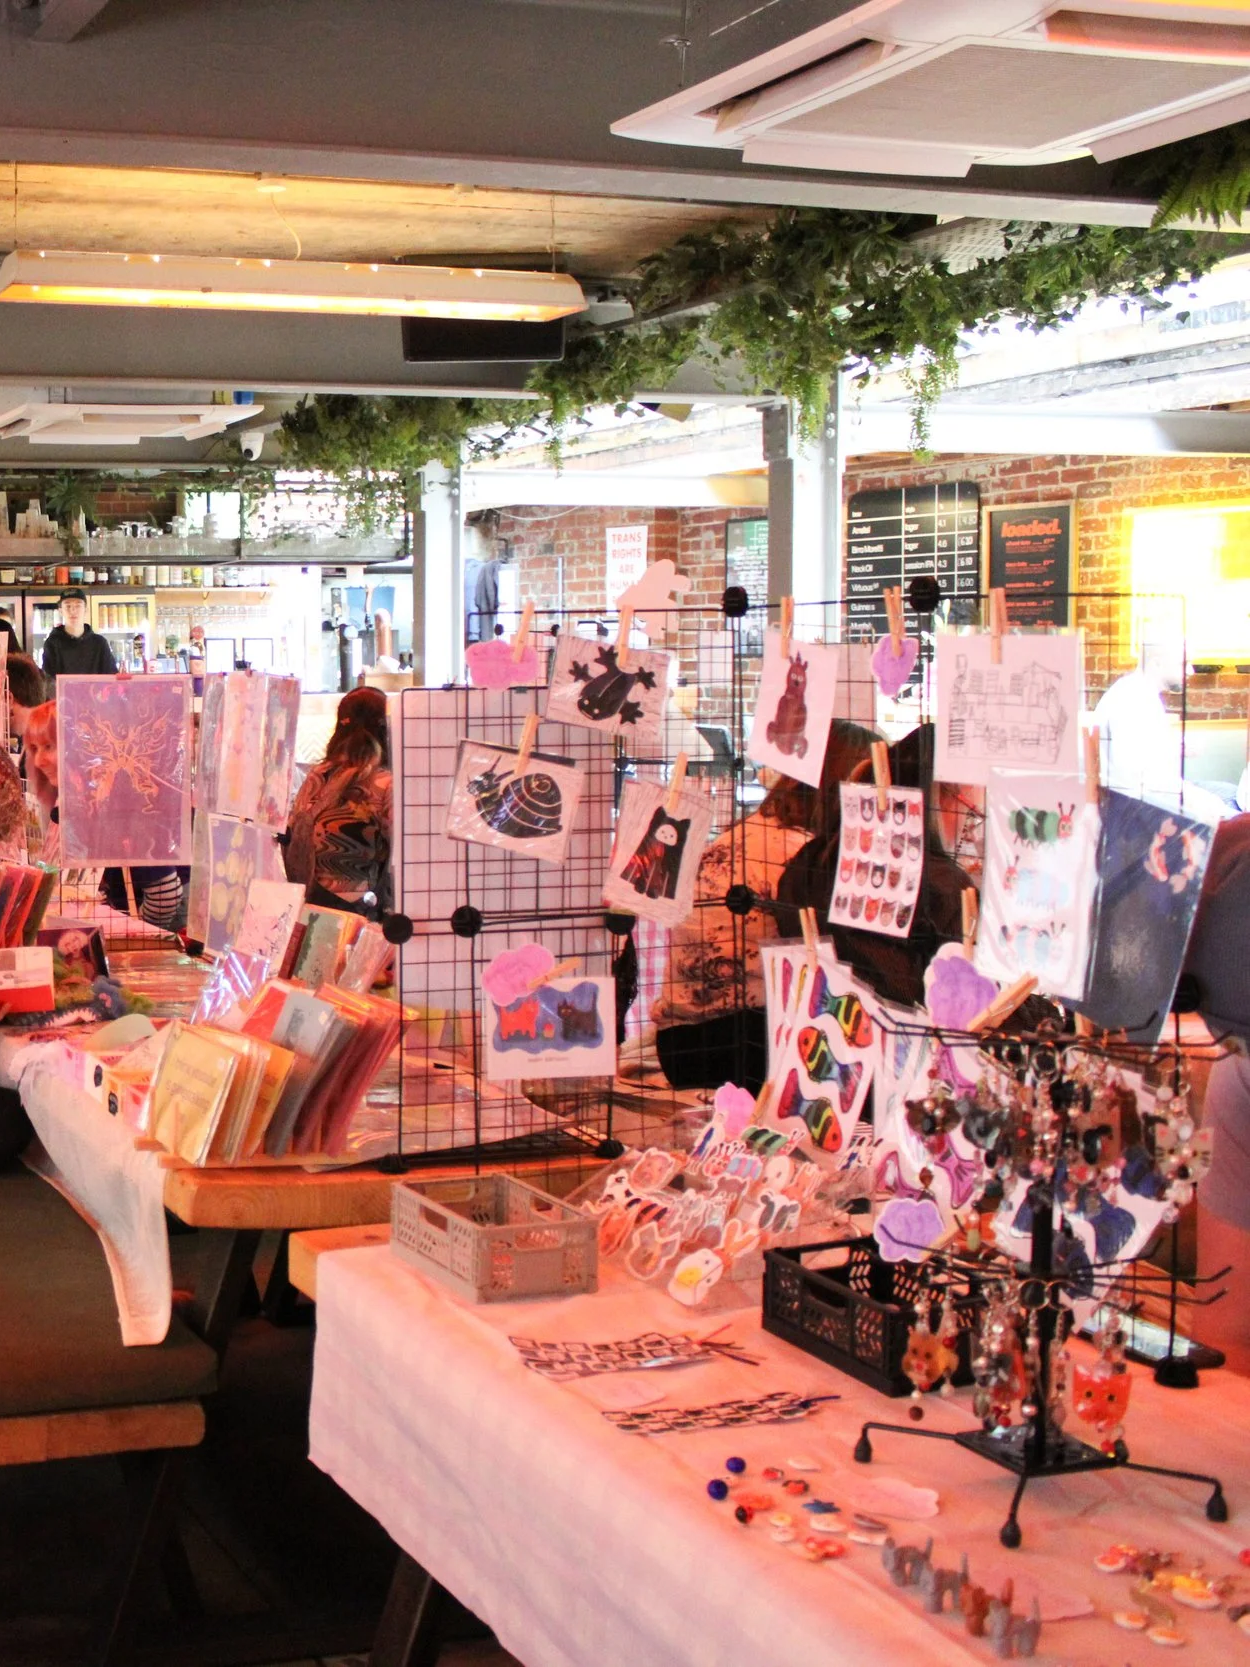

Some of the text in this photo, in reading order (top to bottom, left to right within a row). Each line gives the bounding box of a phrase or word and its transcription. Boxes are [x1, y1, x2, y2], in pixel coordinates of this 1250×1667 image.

[611, 532, 642, 544] TRANS
[611, 548, 642, 560] RIGHTS
[618, 564, 634, 574] ARE
